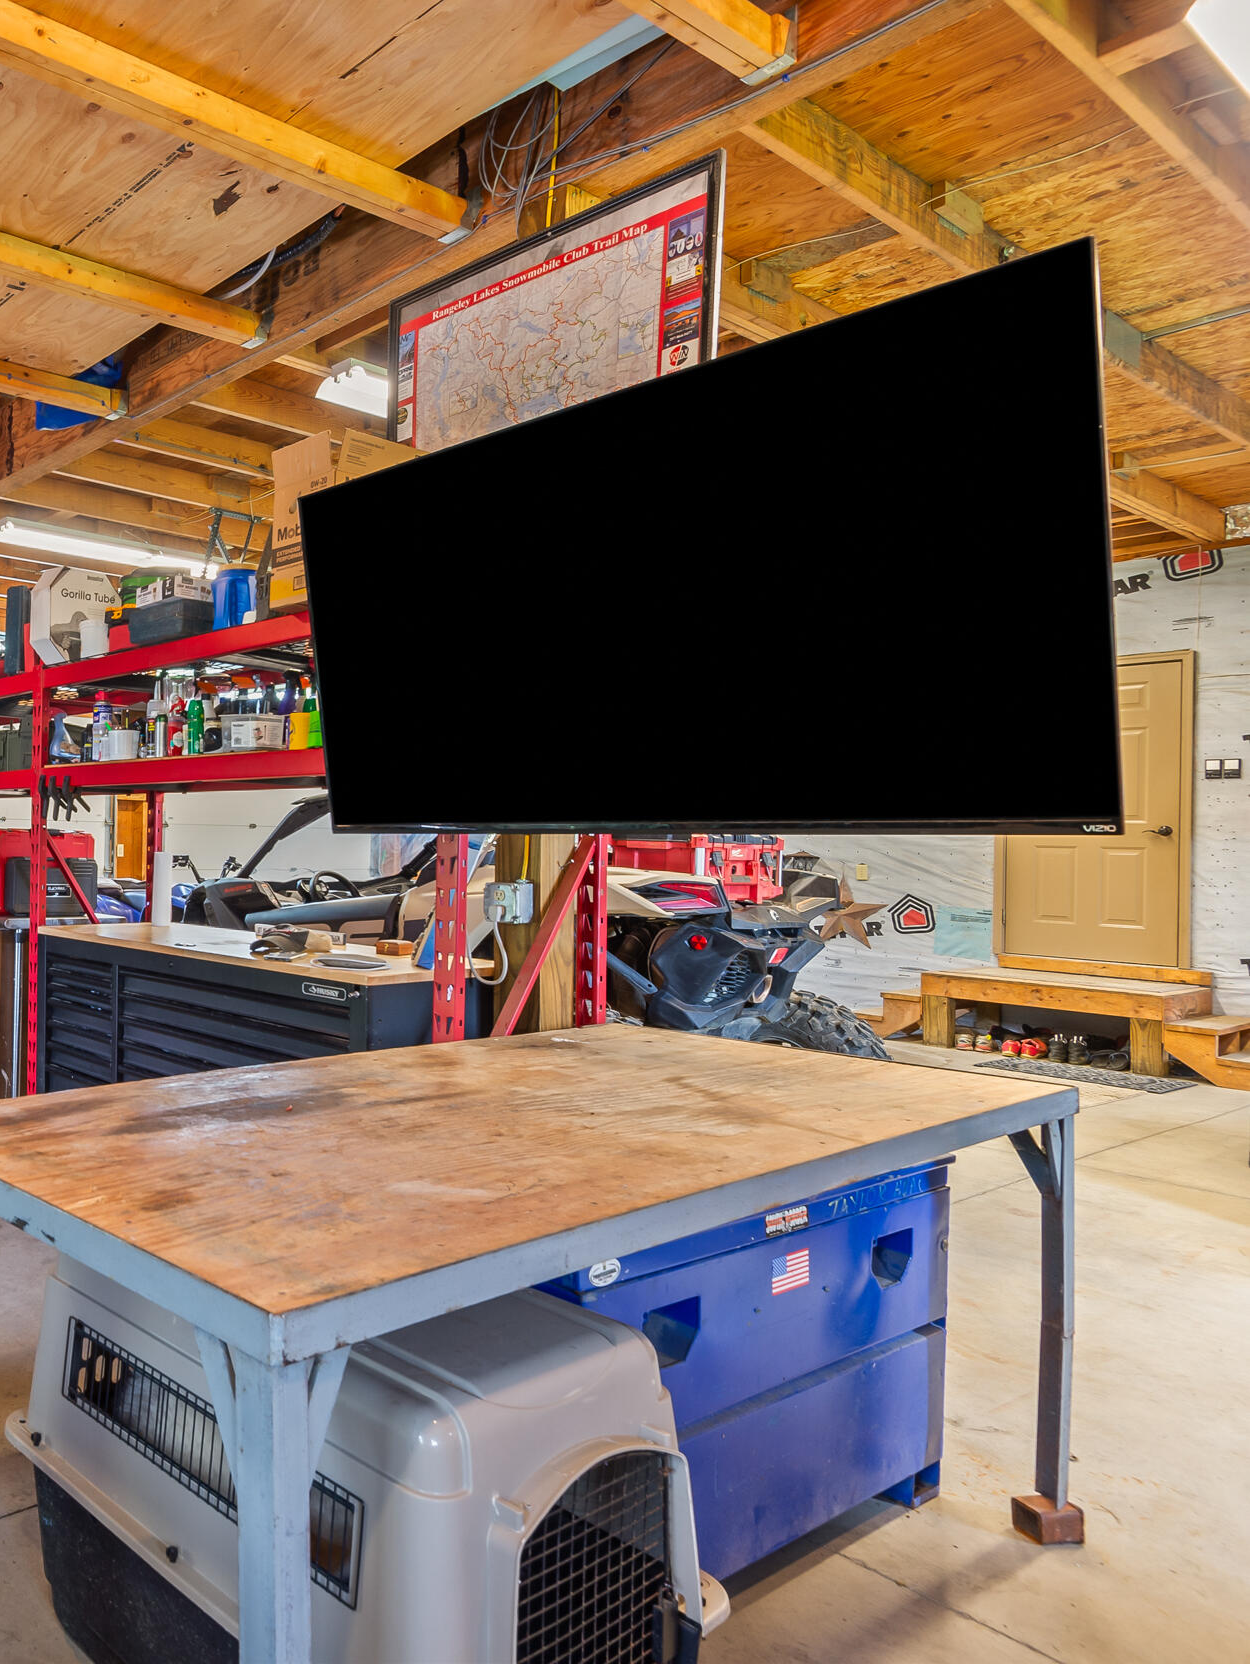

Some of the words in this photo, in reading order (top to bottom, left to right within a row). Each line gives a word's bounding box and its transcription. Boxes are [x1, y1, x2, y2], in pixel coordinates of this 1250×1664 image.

[432, 298, 471, 320] Rangeley
[473, 286, 500, 303] Lakes
[502, 259, 561, 290] Snowmobile
[563, 247, 589, 264] Club
[592, 234, 619, 252] Trail
[621, 223, 648, 241] Map
[277, 523, 301, 542] Mob
[61, 587, 92, 601] Gorilla
[94, 592, 116, 604] Tube
[1082, 824, 1117, 833] VIZIO
